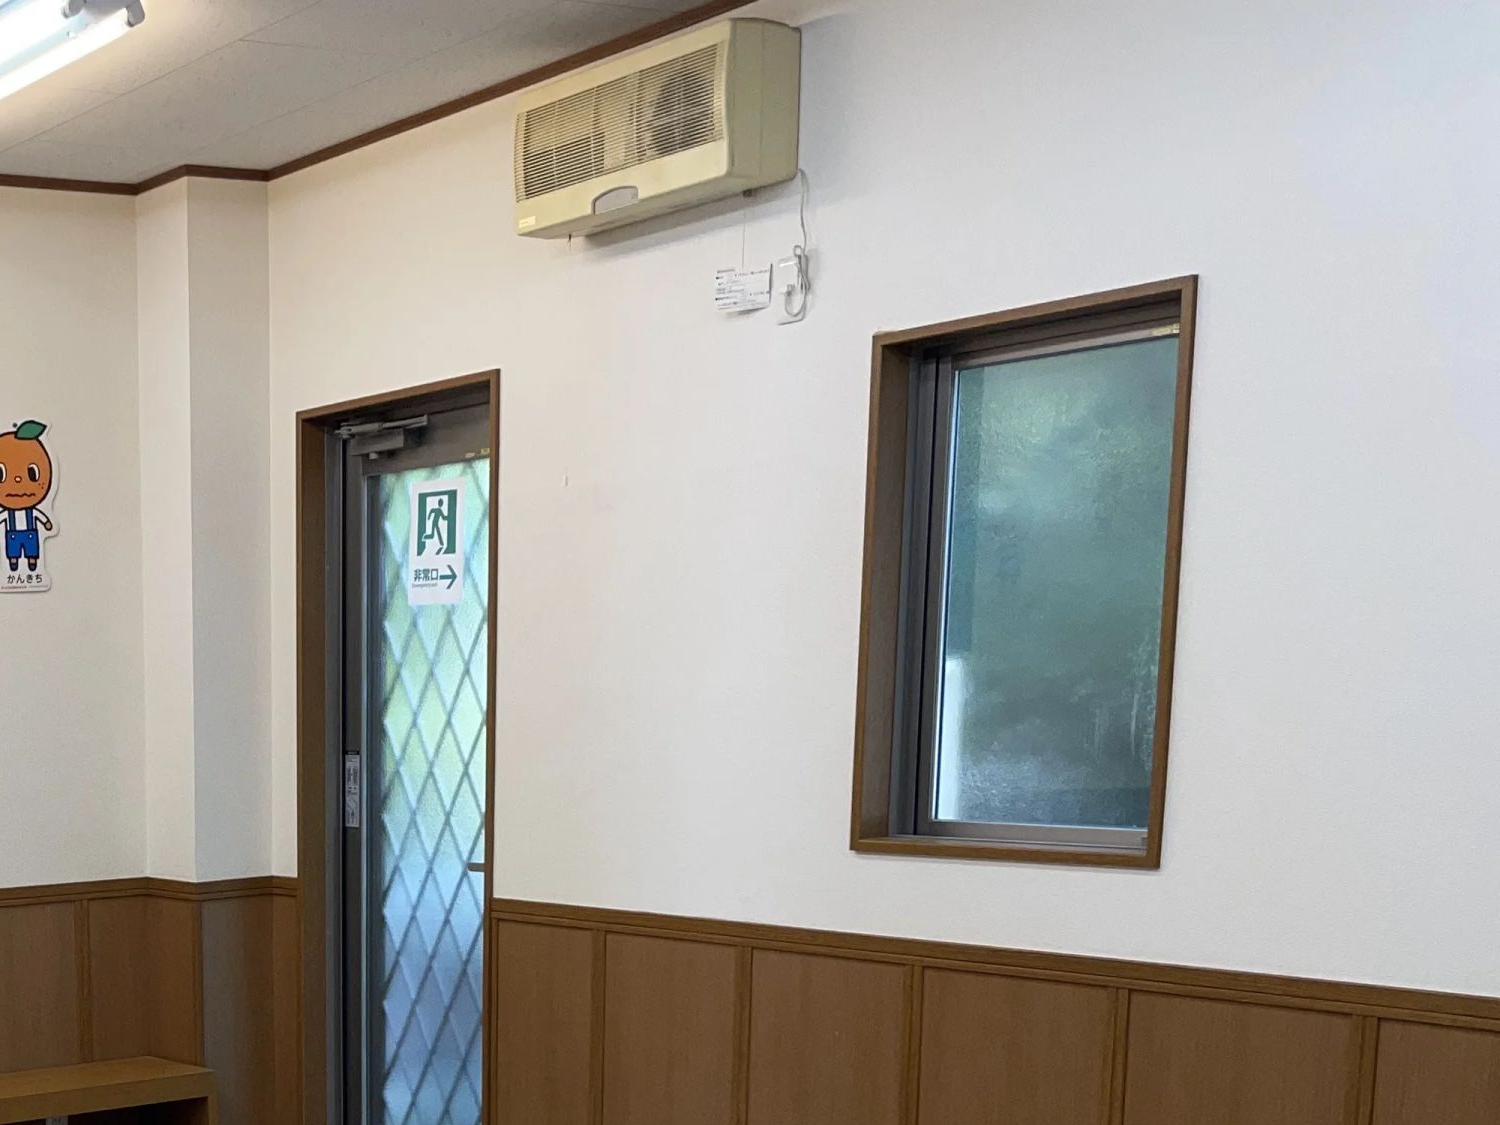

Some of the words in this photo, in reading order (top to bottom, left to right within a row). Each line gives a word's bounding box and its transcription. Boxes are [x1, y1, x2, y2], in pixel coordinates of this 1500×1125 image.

[6, 573, 43, 584] かんきち
[413, 568, 439, 582] 非常口
